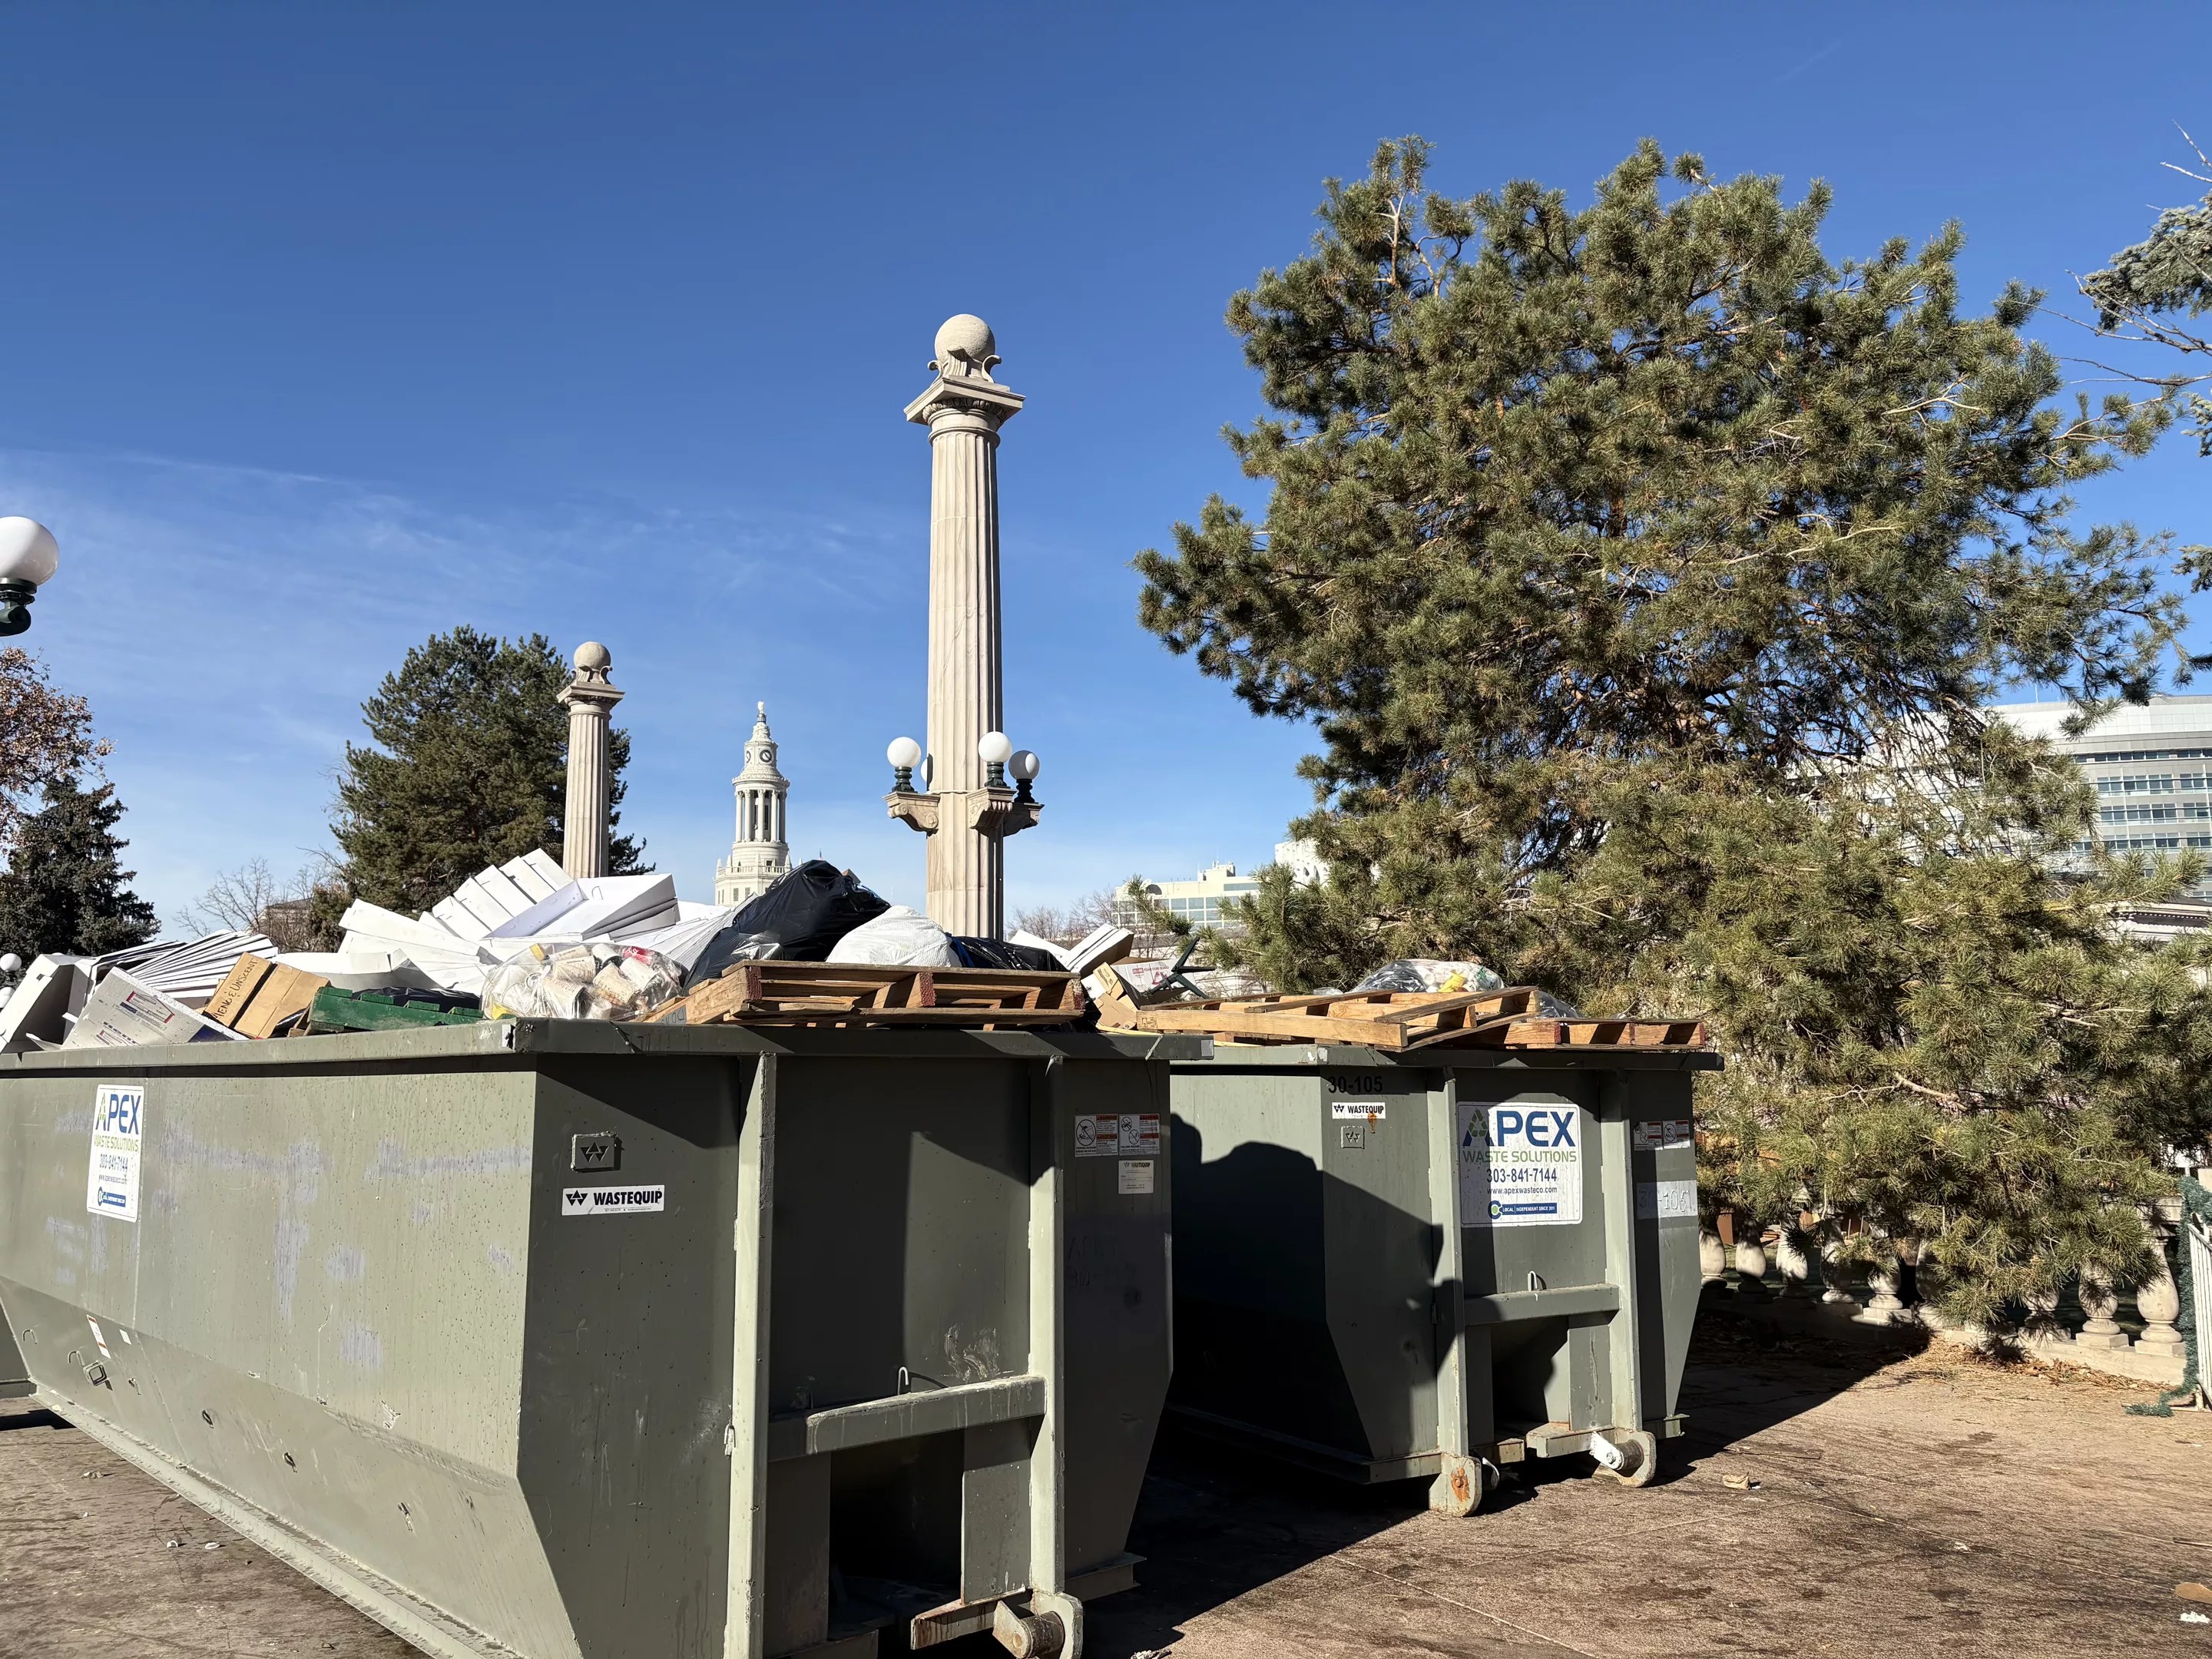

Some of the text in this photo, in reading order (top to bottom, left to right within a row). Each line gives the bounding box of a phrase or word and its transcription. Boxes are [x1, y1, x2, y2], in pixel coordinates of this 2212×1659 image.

[1329, 1076, 1382, 1093] 30-105
[95, 1092, 141, 1134] APEX
[1347, 1105, 1384, 1114] WASTEQUIP
[1462, 1109, 1576, 1147] APEX
[111, 1137, 139, 1151] SOLUTIONS
[1462, 1151, 1577, 1163] WASTE SOLUTIONS
[1487, 1168, 1557, 1183] 303-841-7144
[593, 1190, 663, 1205] WASTEQUIP
[1487, 1187, 1558, 1195] www.apexwasteco.com
